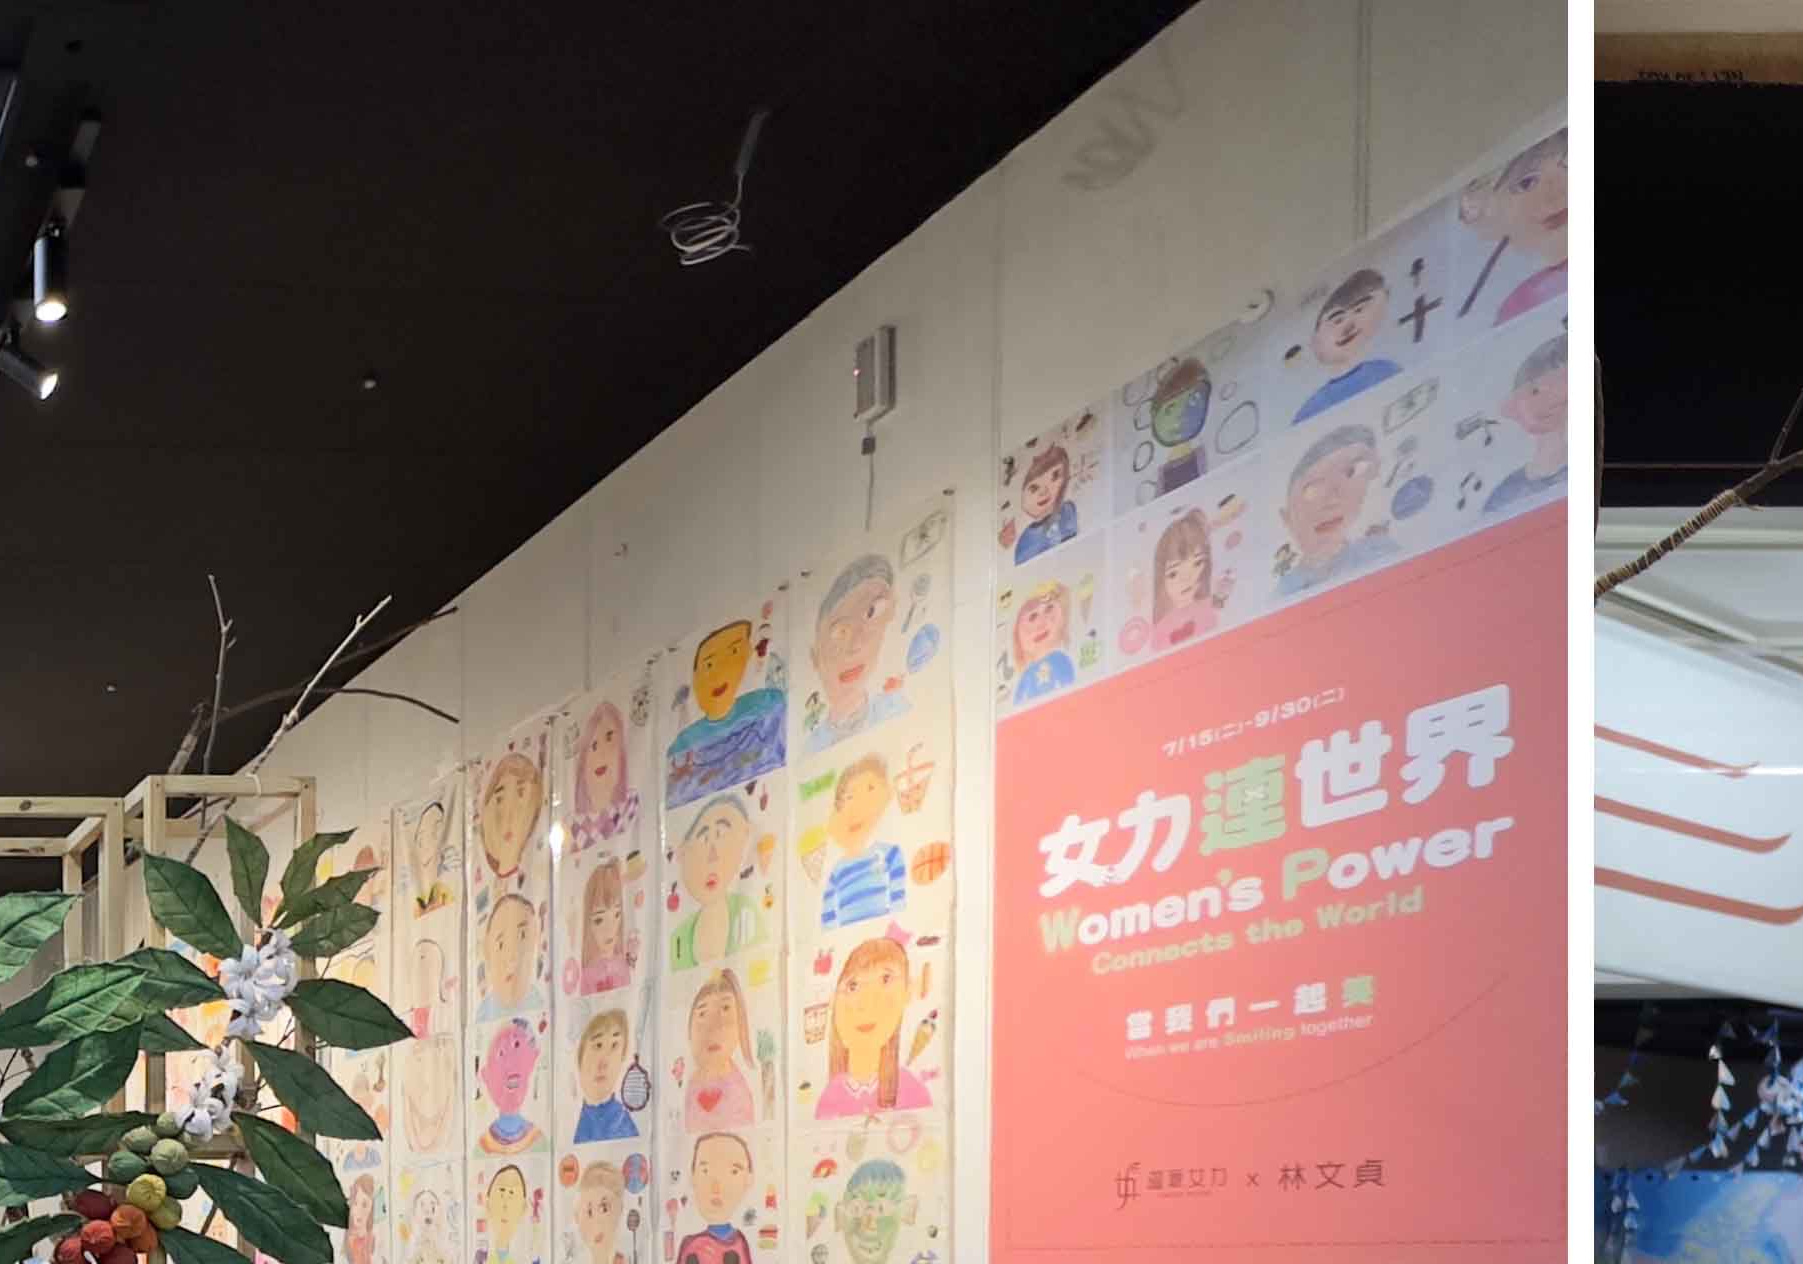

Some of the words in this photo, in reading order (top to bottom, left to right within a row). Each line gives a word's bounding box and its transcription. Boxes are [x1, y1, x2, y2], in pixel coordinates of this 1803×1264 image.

[1037, 683, 1516, 898] 女力連世界
[1039, 867, 1264, 956] Women's
[1280, 816, 1515, 901] Power
[1091, 921, 1234, 977] Connects
[1246, 906, 1304, 945] the
[1316, 885, 1425, 930] World
[1278, 1158, 1387, 1191] 林文貞
